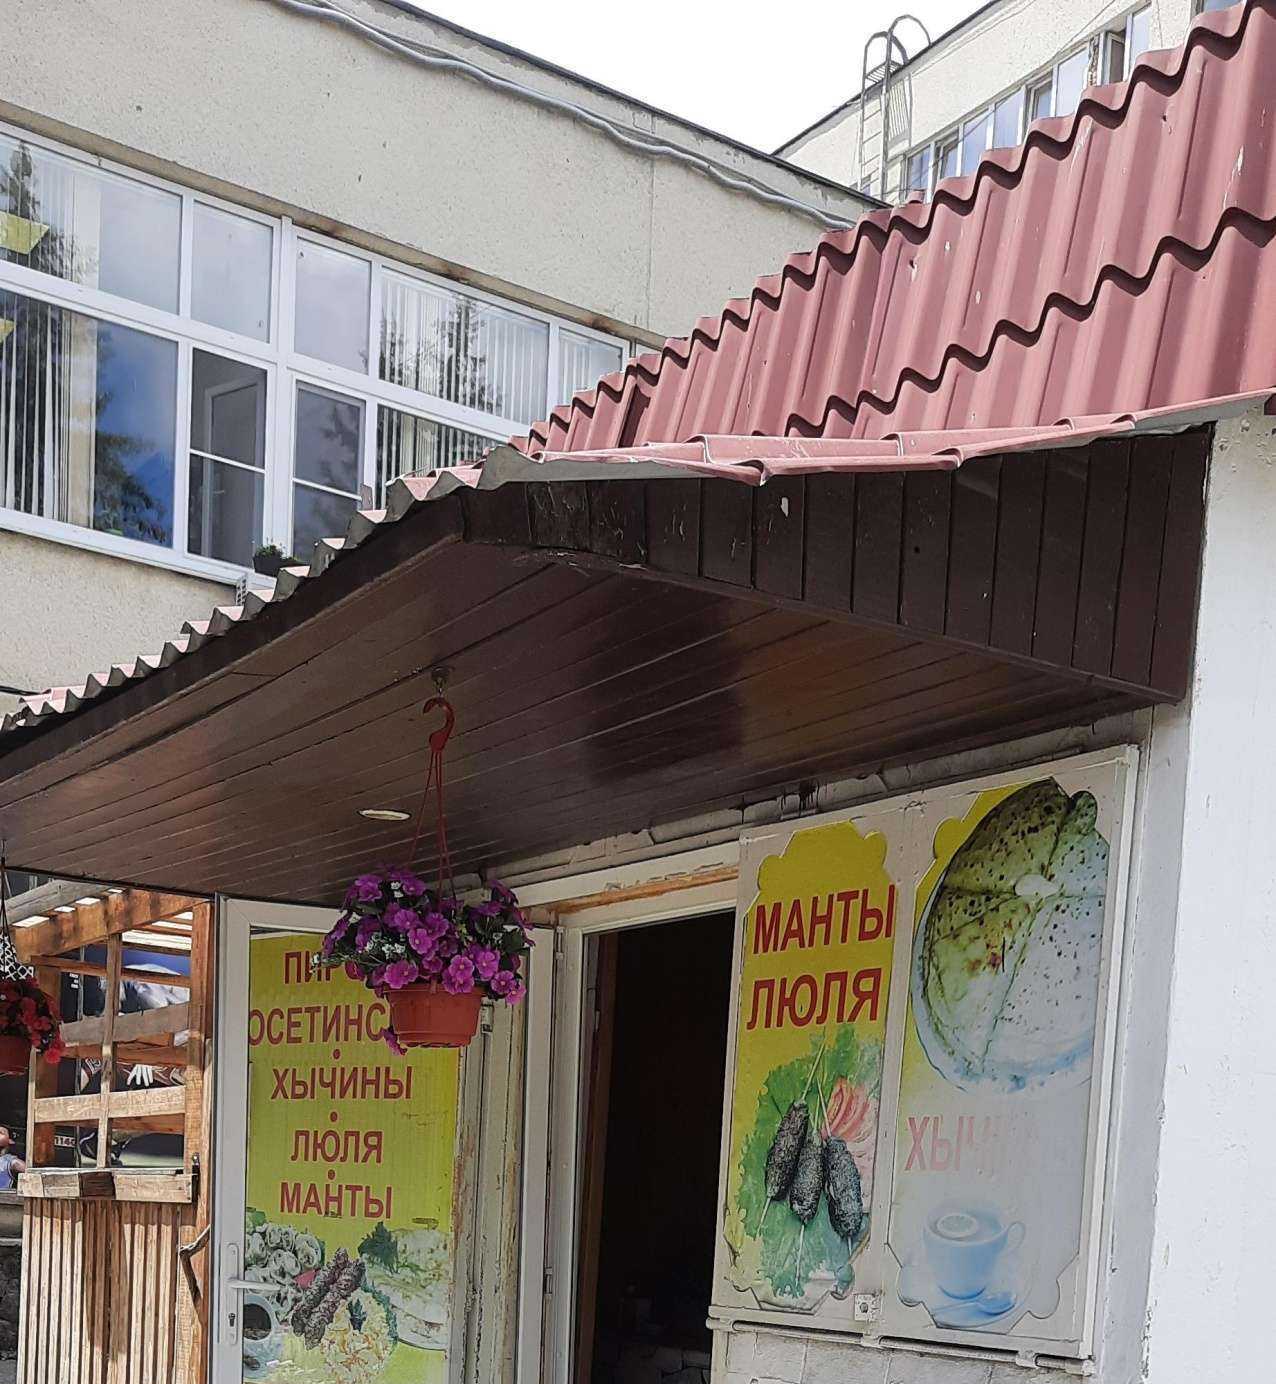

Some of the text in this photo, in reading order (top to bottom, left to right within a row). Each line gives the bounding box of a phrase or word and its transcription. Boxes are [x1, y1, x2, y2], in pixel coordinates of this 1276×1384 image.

[753, 884, 895, 954] МАНТЫ
[747, 968, 882, 1030] ЛЮЛЯ
[248, 1003, 389, 1046] ОСЕТИНС
[271, 1066, 413, 1100] ХЫЧИНЫ
[291, 1129, 384, 1163] ЛЮЛЯ
[280, 1182, 393, 1219] МАНТЫ
